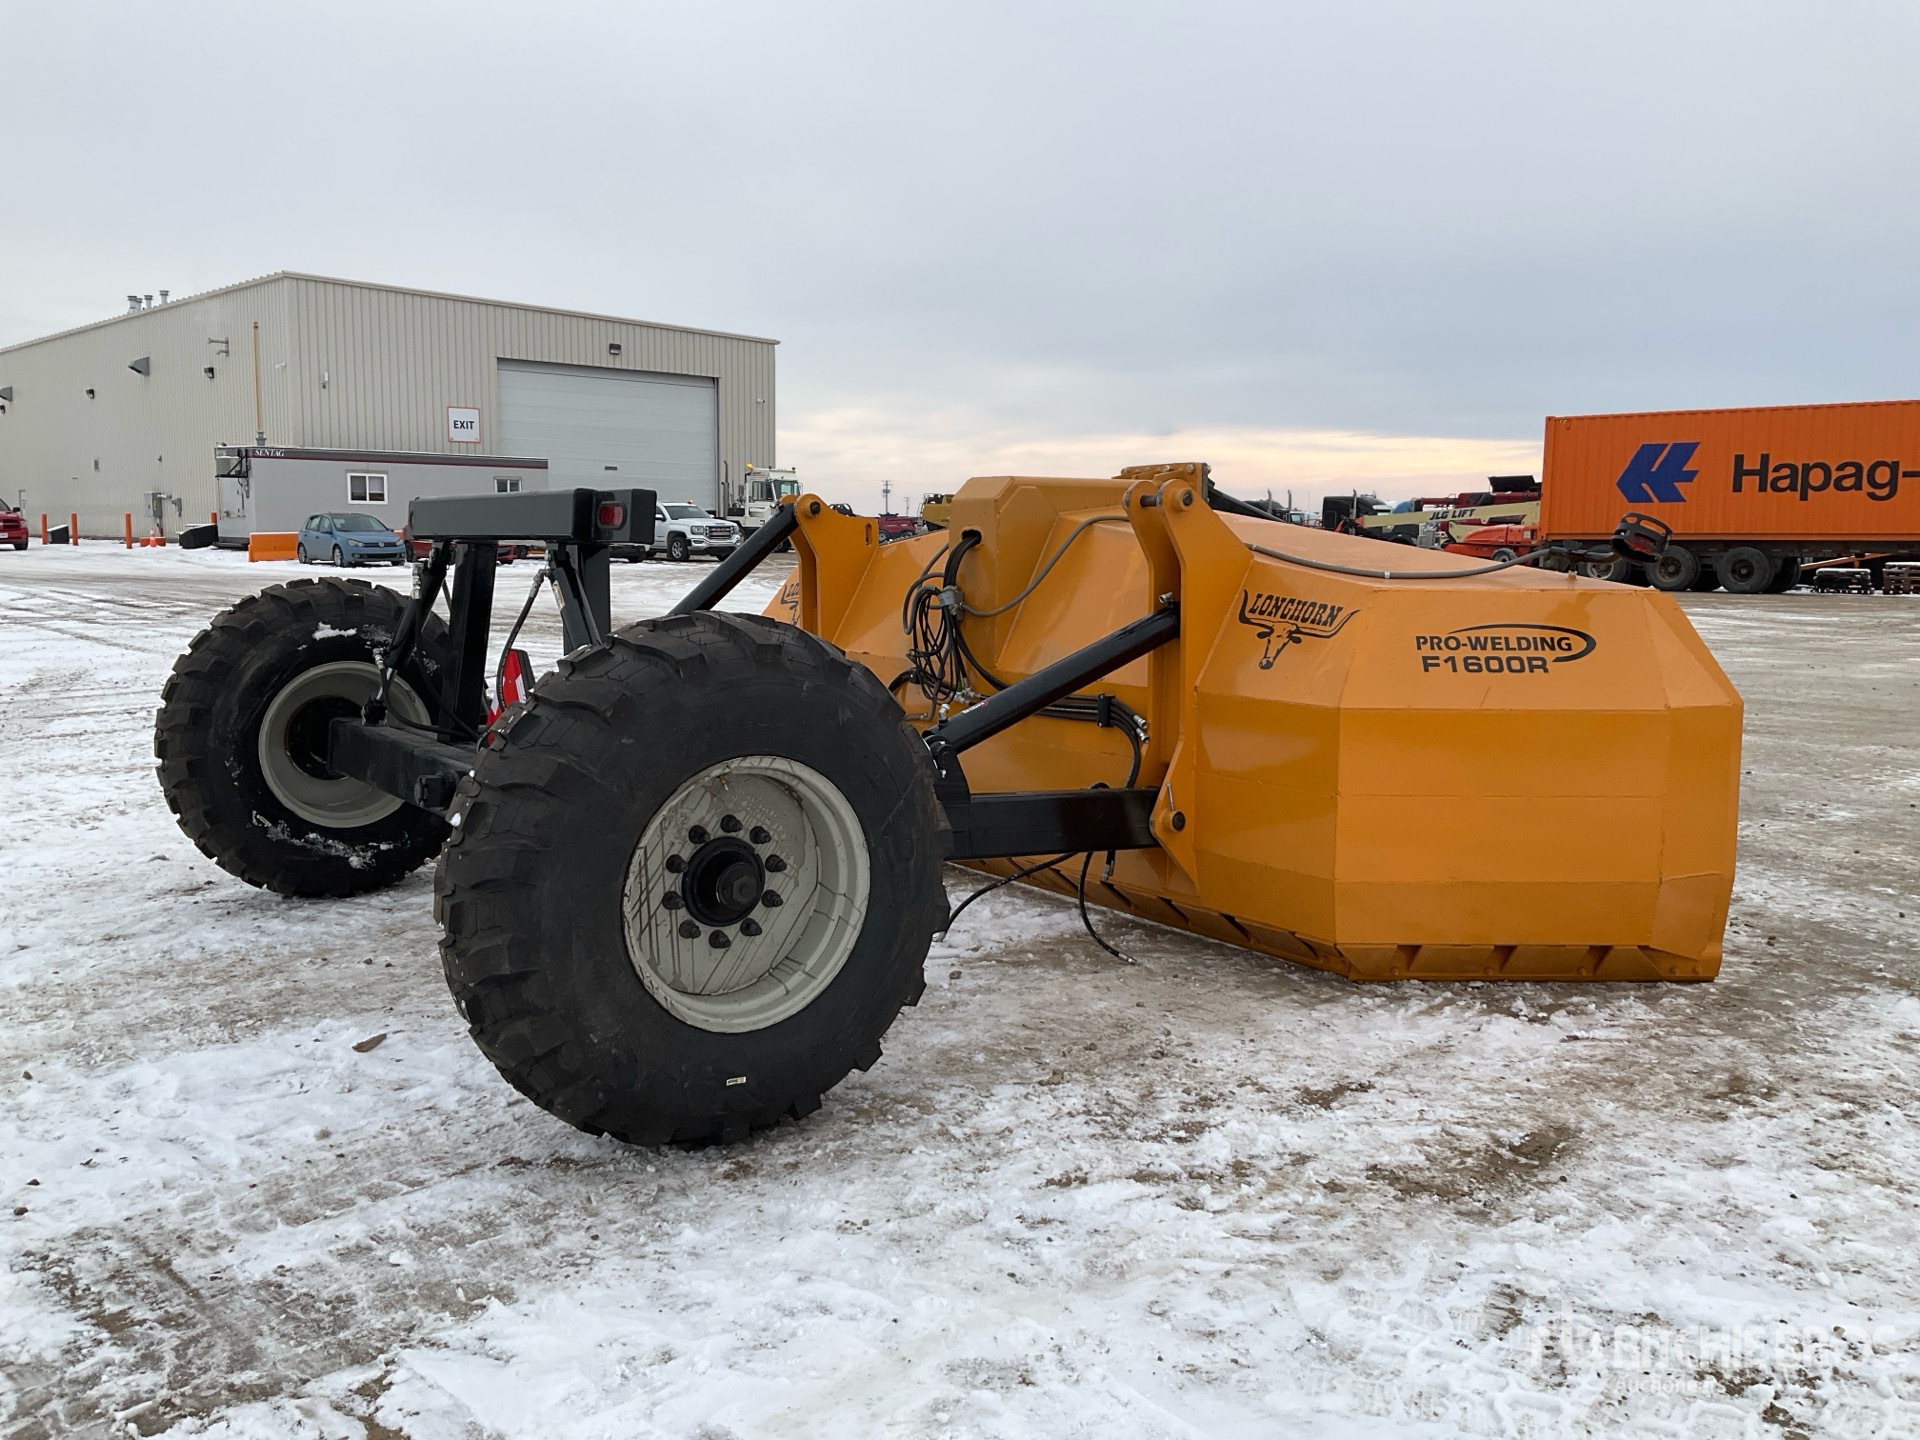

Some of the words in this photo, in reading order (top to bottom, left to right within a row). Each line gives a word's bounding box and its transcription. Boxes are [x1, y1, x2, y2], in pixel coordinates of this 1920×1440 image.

[453, 420, 475, 430] EXIT
[1429, 511, 1449, 520] JLG
[1451, 508, 1476, 518] LIFT
[1248, 592, 1344, 628] LONGHORN
[1416, 635, 1573, 652] PRO-WELDING
[1421, 655, 1550, 673] F1600R
